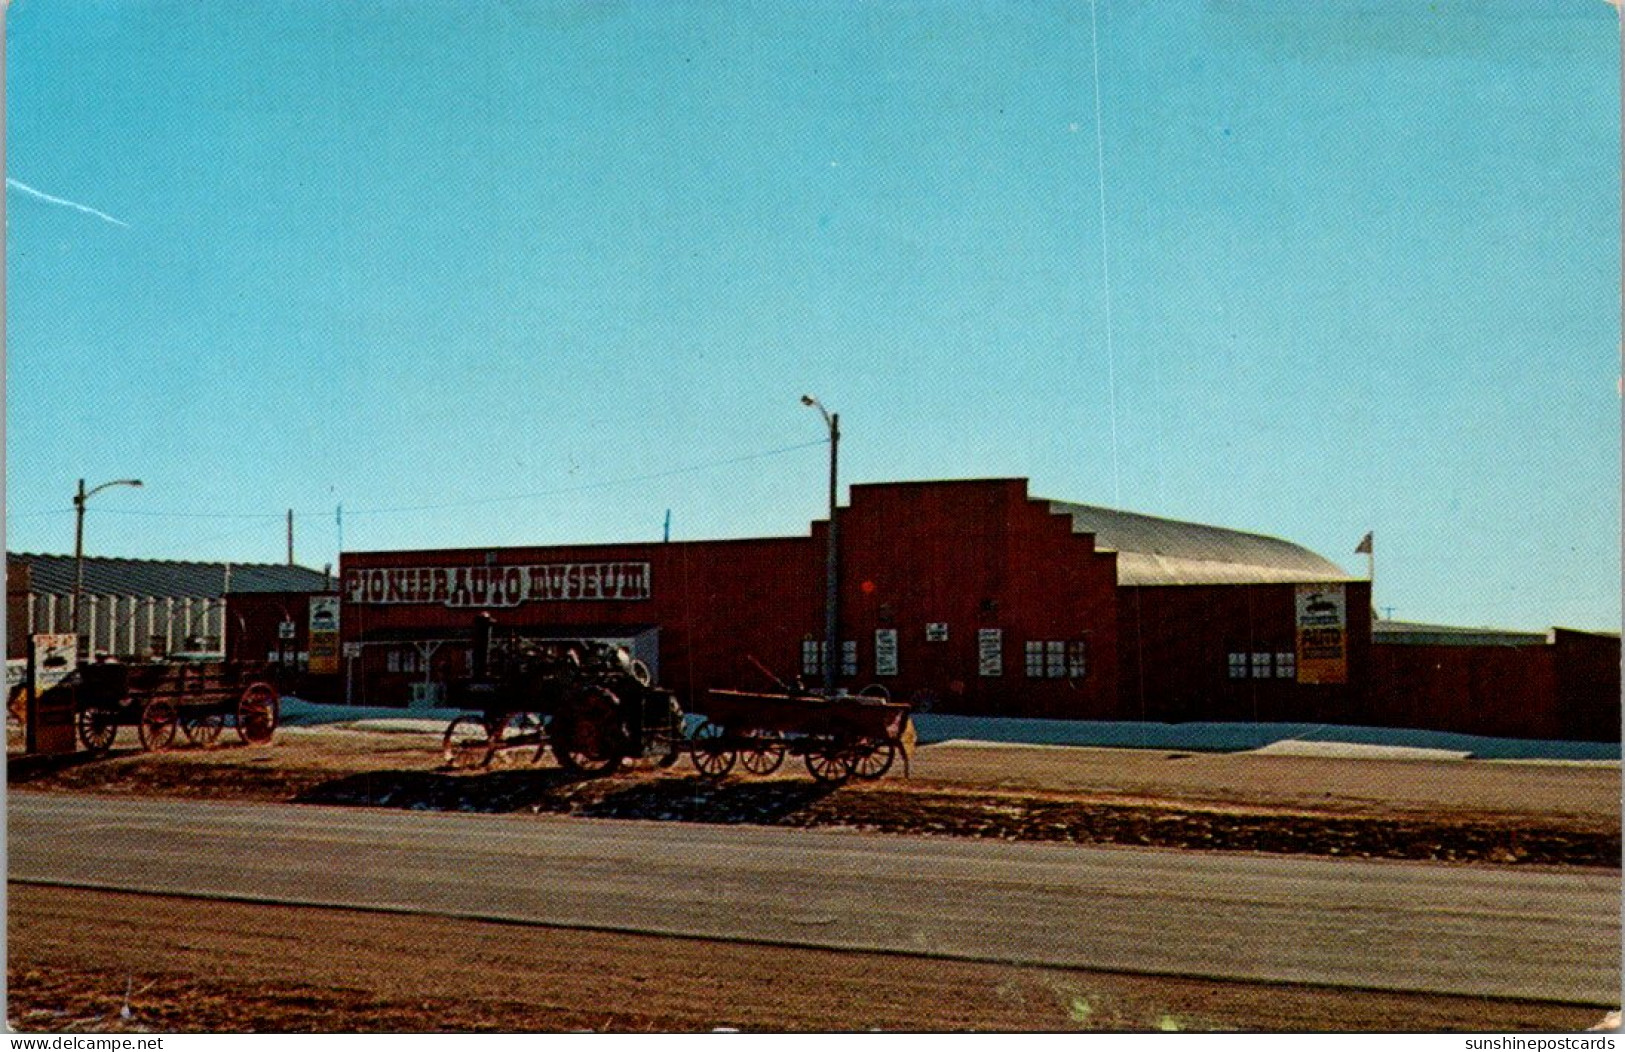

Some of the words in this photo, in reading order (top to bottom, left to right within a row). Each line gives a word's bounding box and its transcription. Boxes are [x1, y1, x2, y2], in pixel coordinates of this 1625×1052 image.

[345, 567, 449, 602] PIONEER
[450, 565, 522, 605] AUTO
[527, 562, 649, 600] MUSEUM
